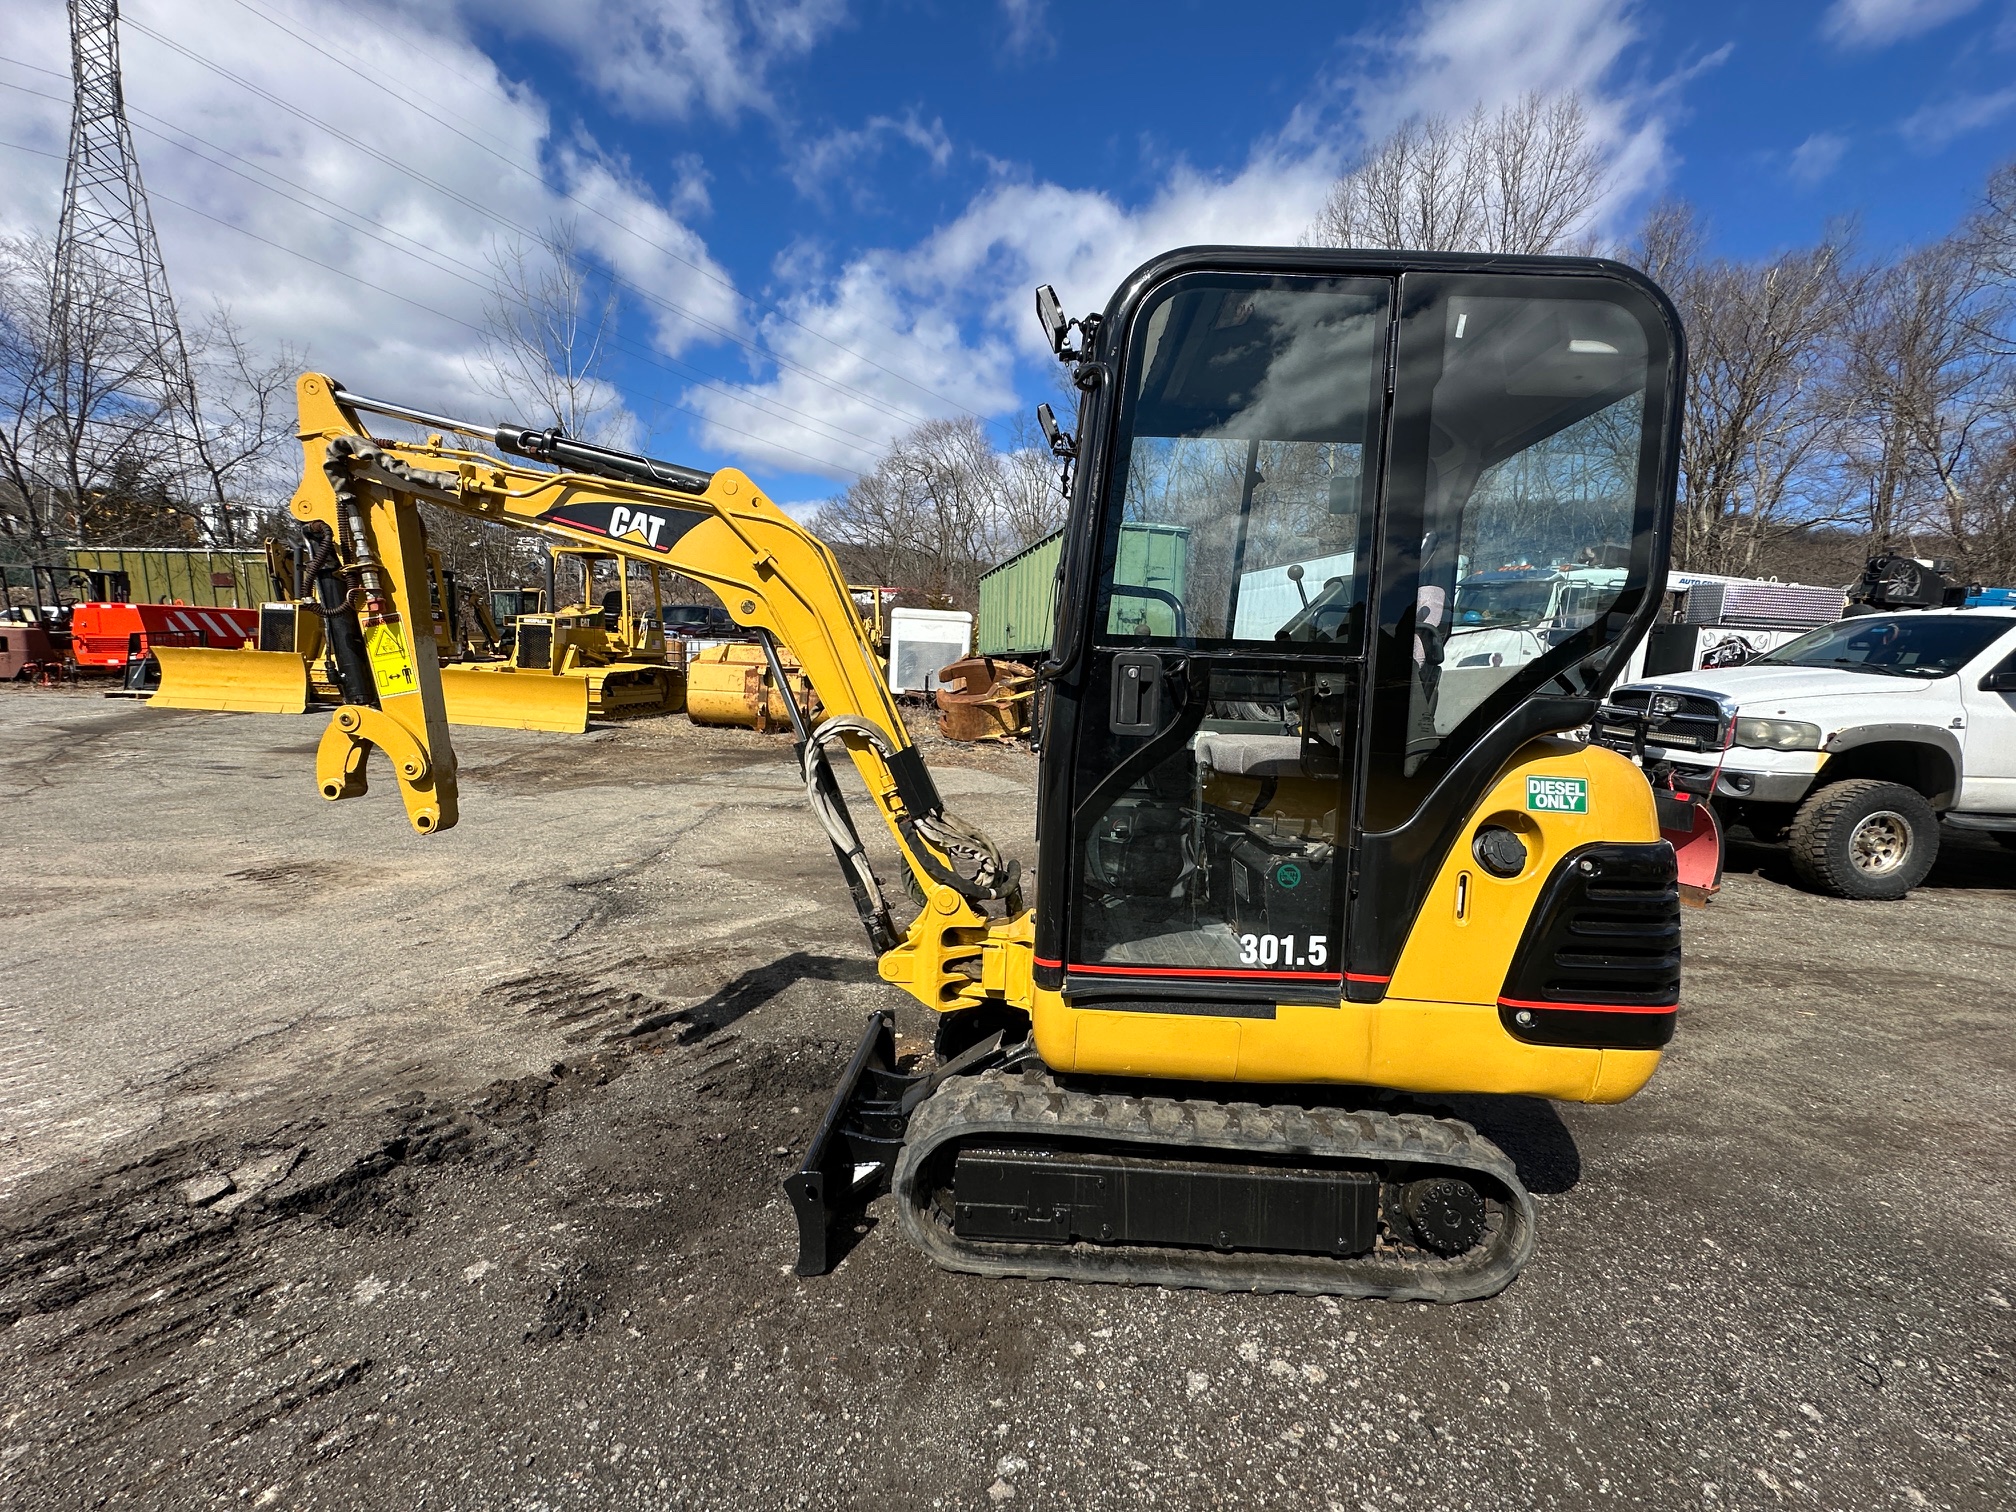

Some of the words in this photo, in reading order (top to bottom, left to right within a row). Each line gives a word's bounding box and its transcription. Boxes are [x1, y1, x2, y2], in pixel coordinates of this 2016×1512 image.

[609, 506, 666, 547] CAT
[1678, 578, 1700, 586] AUTO
[580, 617, 590, 627] CAT
[1529, 779, 1585, 797] DIESEL
[1535, 793, 1579, 810] ONLY
[1239, 933, 1328, 966] 301.5
